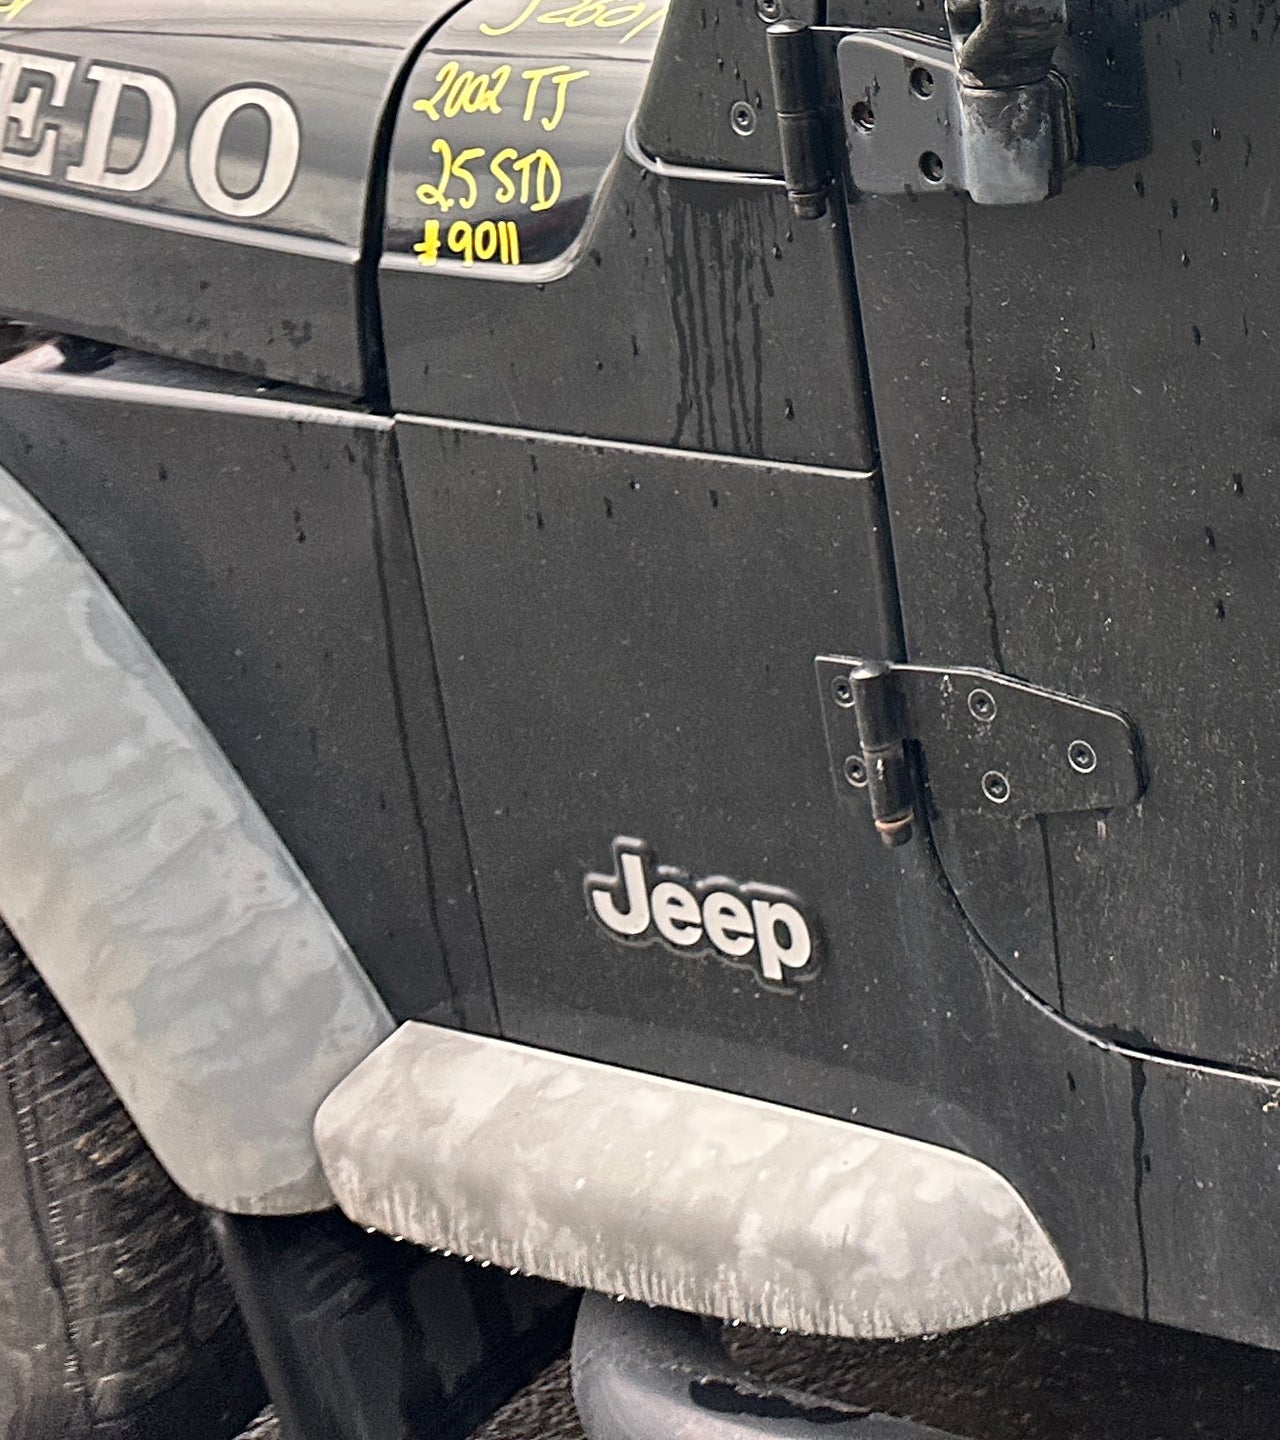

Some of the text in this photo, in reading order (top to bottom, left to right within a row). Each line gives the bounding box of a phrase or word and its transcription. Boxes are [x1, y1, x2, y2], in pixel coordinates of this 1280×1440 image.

[413, 61, 590, 131] 2002 TJ
[490, 147, 562, 212] STD
[413, 219, 521, 267] #9011
[590, 850, 813, 981] Jeep
